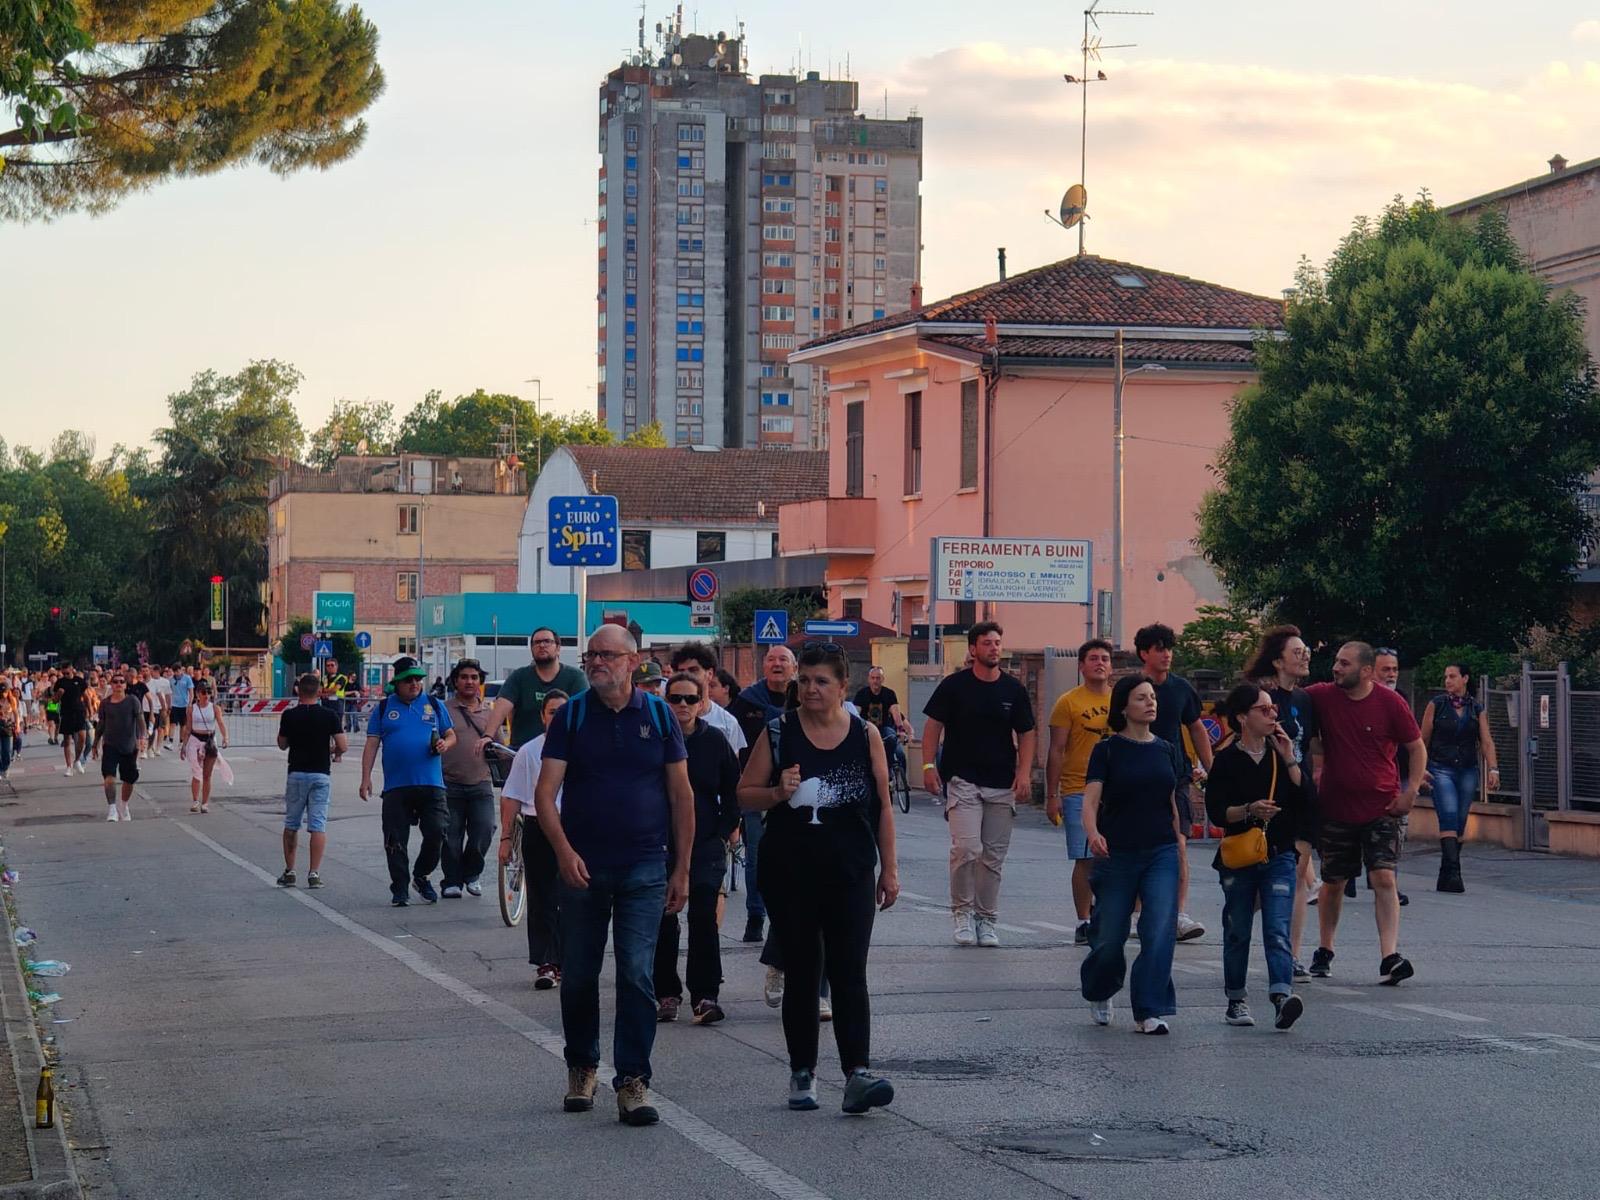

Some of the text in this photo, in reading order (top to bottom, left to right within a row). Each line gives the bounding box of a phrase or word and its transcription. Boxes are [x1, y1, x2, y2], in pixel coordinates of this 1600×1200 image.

[567, 511, 600, 524] EURO
[561, 525, 605, 551] Spin
[942, 542, 1084, 557] FERRAMENTA BUINI
[948, 560, 994, 569] EMPORIO
[948, 569, 963, 578] FAI
[977, 571, 1026, 579] INGROSSO
[1040, 572, 1075, 580] MINUTO
[948, 578, 962, 587] DA
[949, 587, 961, 596] TE
